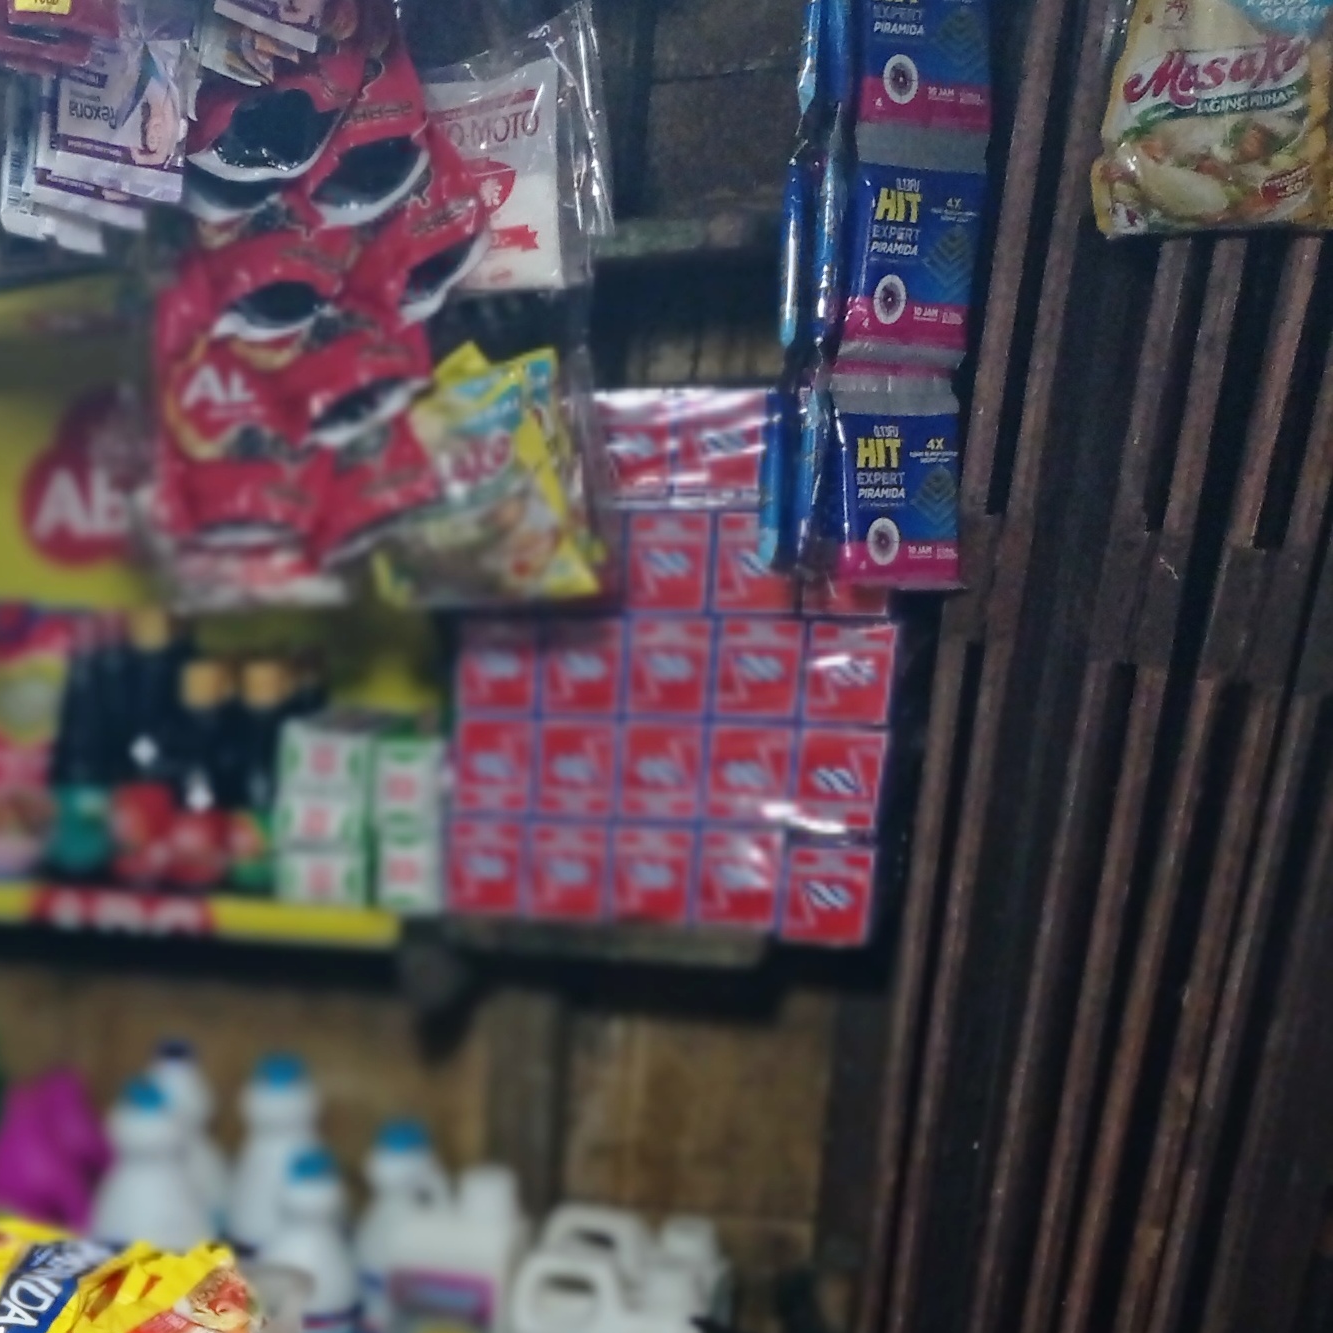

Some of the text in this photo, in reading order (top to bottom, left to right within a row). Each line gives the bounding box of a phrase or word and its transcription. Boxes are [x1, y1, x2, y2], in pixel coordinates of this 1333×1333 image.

[873, 21, 925, 36] PIRAMIDA
[68, 101, 118, 130] Rexona
[874, 187, 923, 223] HIT
[872, 224, 921, 242] EXPERT
[870, 241, 919, 256] PIRAMIDA
[925, 437, 945, 450] 4X
[856, 437, 902, 469] HIT
[856, 471, 906, 486] EXPERT
[857, 487, 906, 499] PIRAMIDA
